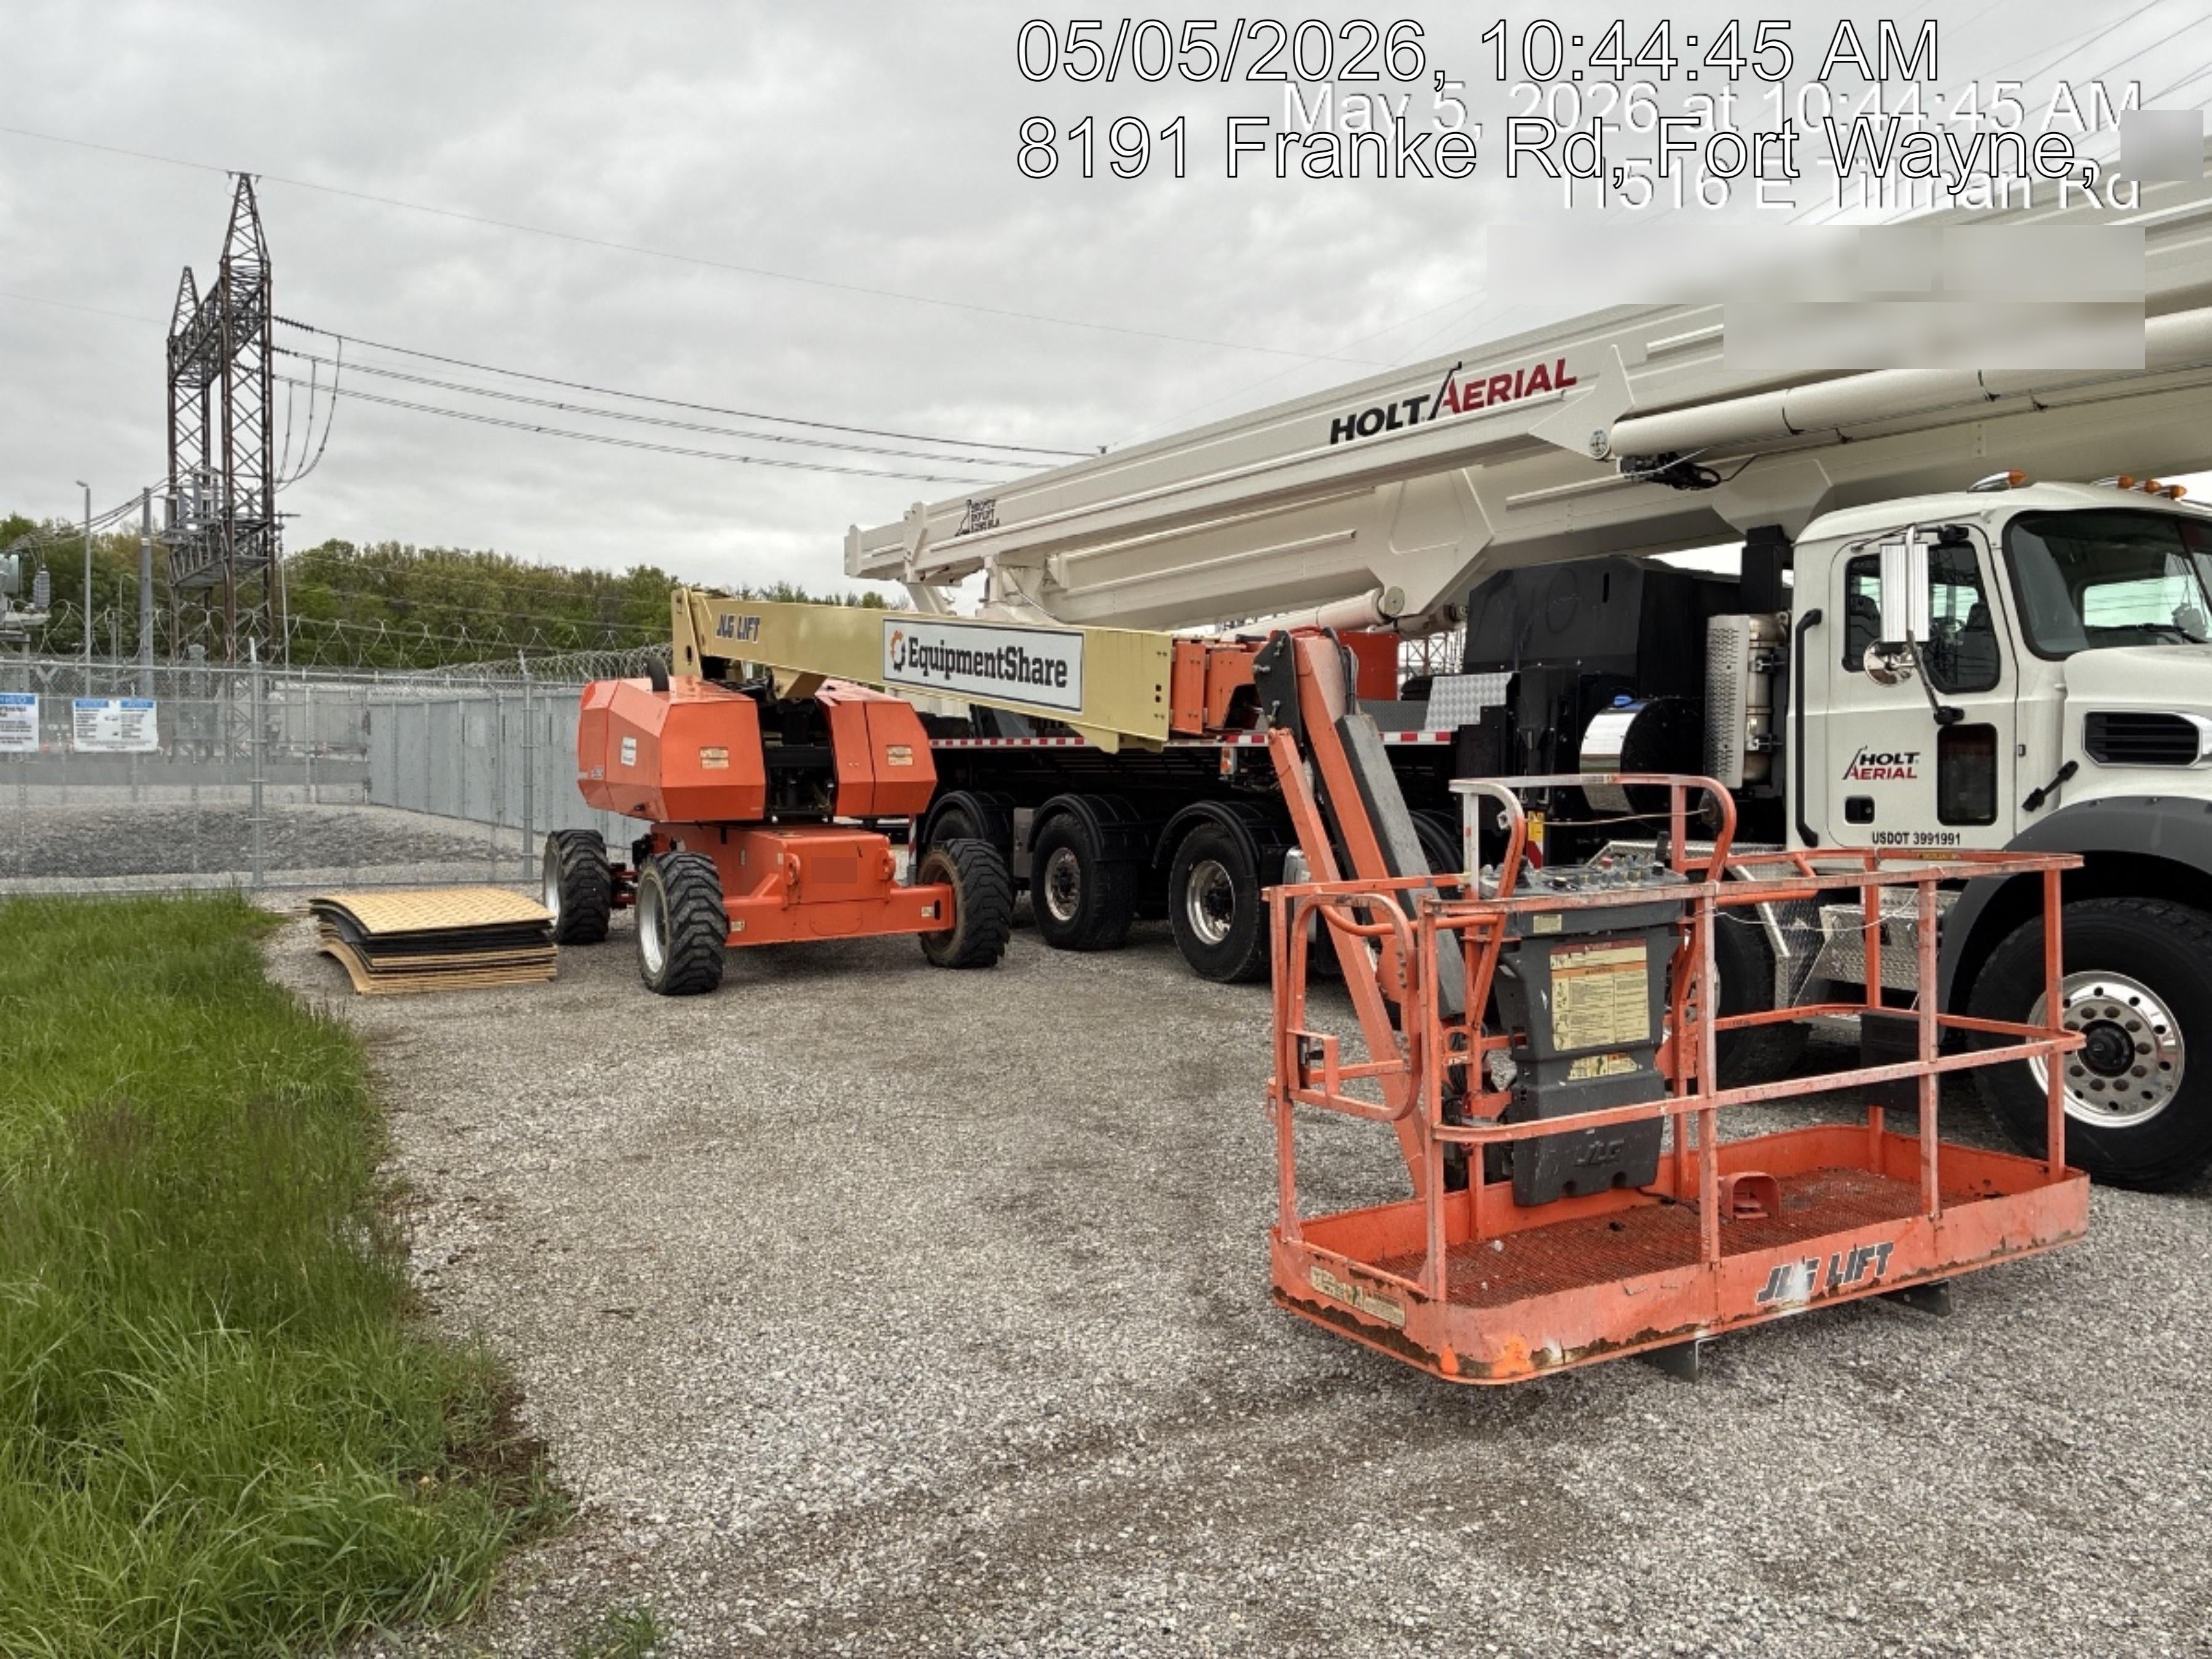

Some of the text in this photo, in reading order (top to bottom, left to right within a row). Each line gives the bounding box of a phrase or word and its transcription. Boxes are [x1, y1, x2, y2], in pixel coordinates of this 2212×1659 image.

[1330, 358, 1577, 444] HOLT AERIAL
[737, 614, 761, 643] LIFT
[908, 635, 1068, 688] EquipmentShare
[1842, 762, 1918, 780] AERIAL
[1859, 752, 1921, 766] HOLT
[1872, 831, 1961, 845] USDOT 3991991
[1823, 1241, 1894, 1289] LIFT
